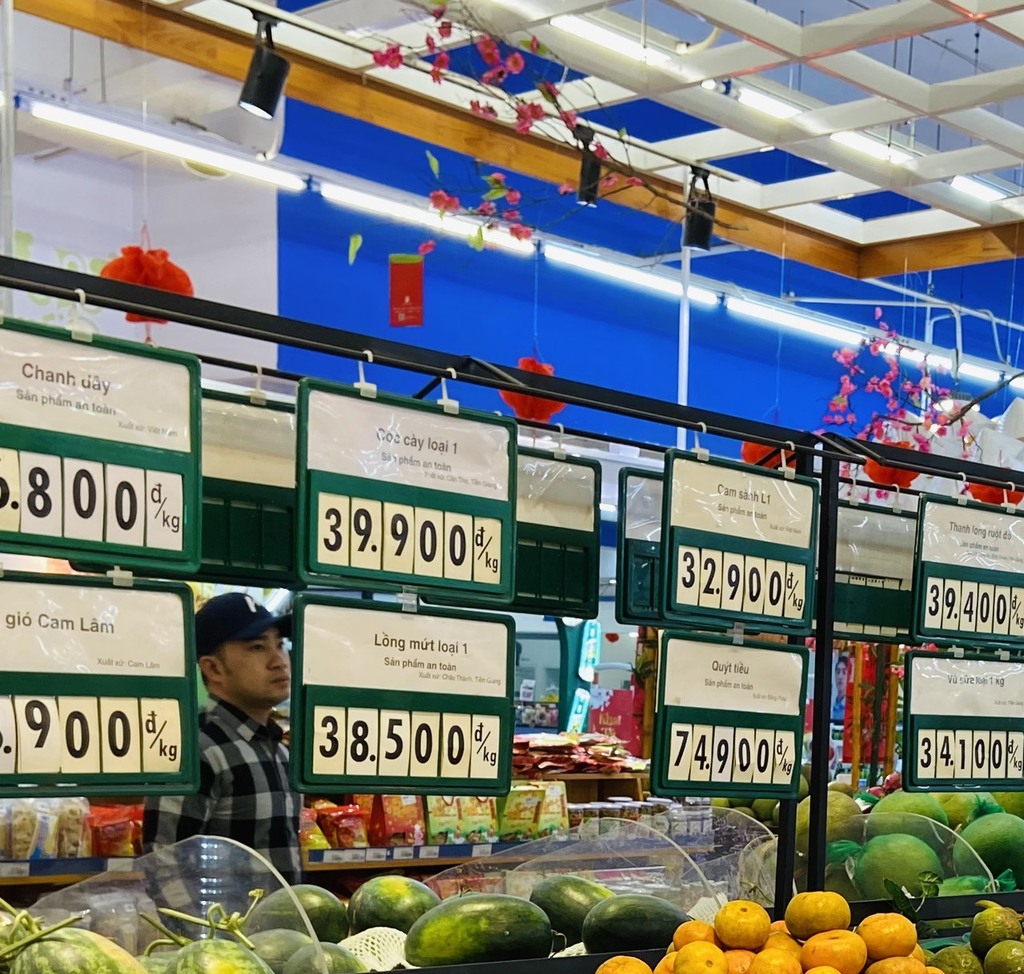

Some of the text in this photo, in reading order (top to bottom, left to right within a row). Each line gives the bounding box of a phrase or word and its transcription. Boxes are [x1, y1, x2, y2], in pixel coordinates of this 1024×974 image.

[22, 363, 75, 387] Chanh
[16, 389, 117, 416] Sản phẩm an toàn
[428, 437, 449, 456] loại
[453, 442, 458, 455] 1
[422, 460, 433, 470] an
[151, 482, 180, 533] đ/kg
[717, 484, 737, 498] Cam
[761, 493, 771, 505] L1
[323, 508, 499, 573] 39.900 đ/kg
[949, 521, 970, 534] Thanh
[971, 525, 987, 539] long
[681, 551, 804, 611] 32.900 đ/kg
[928, 584, 1024, 629] 39.400 đ/kg
[5, 612, 115, 634] gió Cam Lâm
[374, 631, 468, 657] Lồng mứt loại 1
[384, 657, 457, 672] Sản phẩm an toàn
[711, 660, 750, 675] Quýt tiều
[0, 700, 178, 761] .900 đ/kg
[319, 716, 497, 767] 38.500 đ/kg
[674, 731, 793, 776] 74.900 đ/kg
[920, 736, 1023, 772] 34.100 đ/kg
